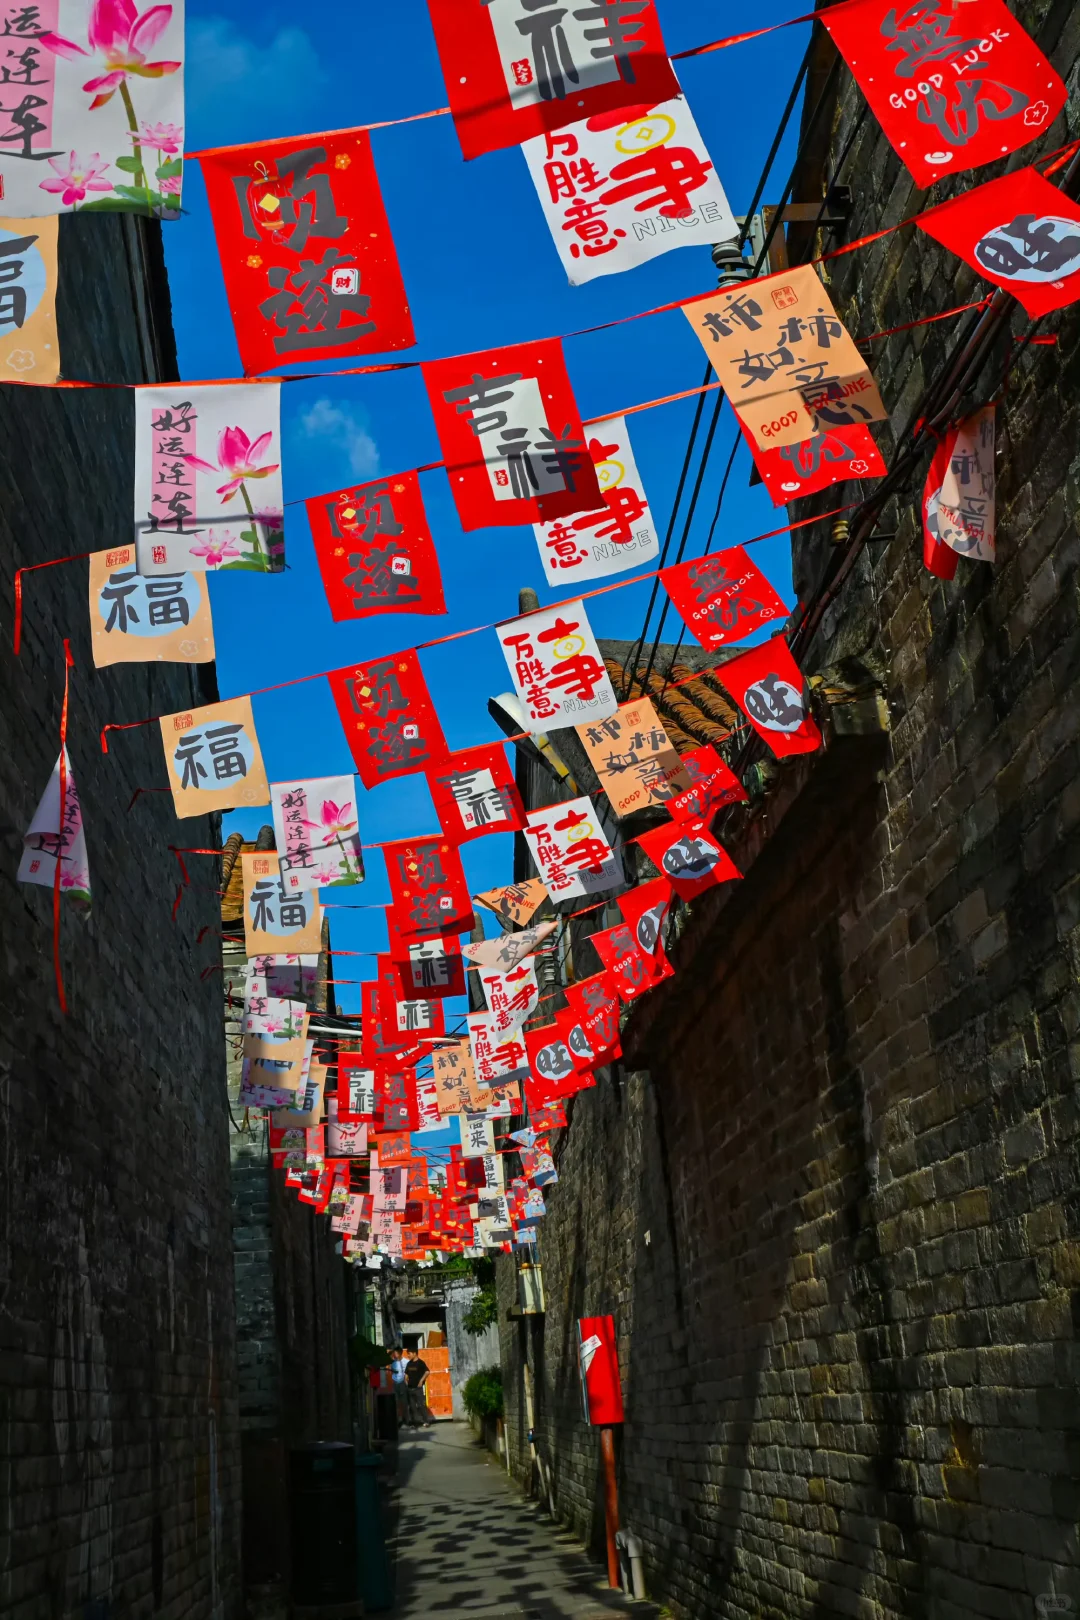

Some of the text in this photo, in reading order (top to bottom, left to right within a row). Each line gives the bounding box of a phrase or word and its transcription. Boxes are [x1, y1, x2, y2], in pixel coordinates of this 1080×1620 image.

[889, 27, 1010, 109] GOOD LUCK
[632, 202, 723, 241] NICE
[760, 376, 872, 438] GOOD FORTUNE
[442, 372, 584, 500] 吉祥
[592, 530, 652, 562] NICE
[101, 572, 190, 633] 福
[692, 571, 756, 620] GOOD LUCK
[502, 632, 561, 719] 万胜意
[562, 689, 611, 714] NICE
[174, 723, 248, 791] 福
[435, 766, 517, 827] 吉祥
[618, 789, 641, 810] GOOD
[675, 767, 724, 809] GOOD LUCK
[525, 823, 576, 892] 万胜意
[577, 864, 617, 884] NICE
[250, 880, 307, 932] 福
[613, 956, 633, 974] GOOD
